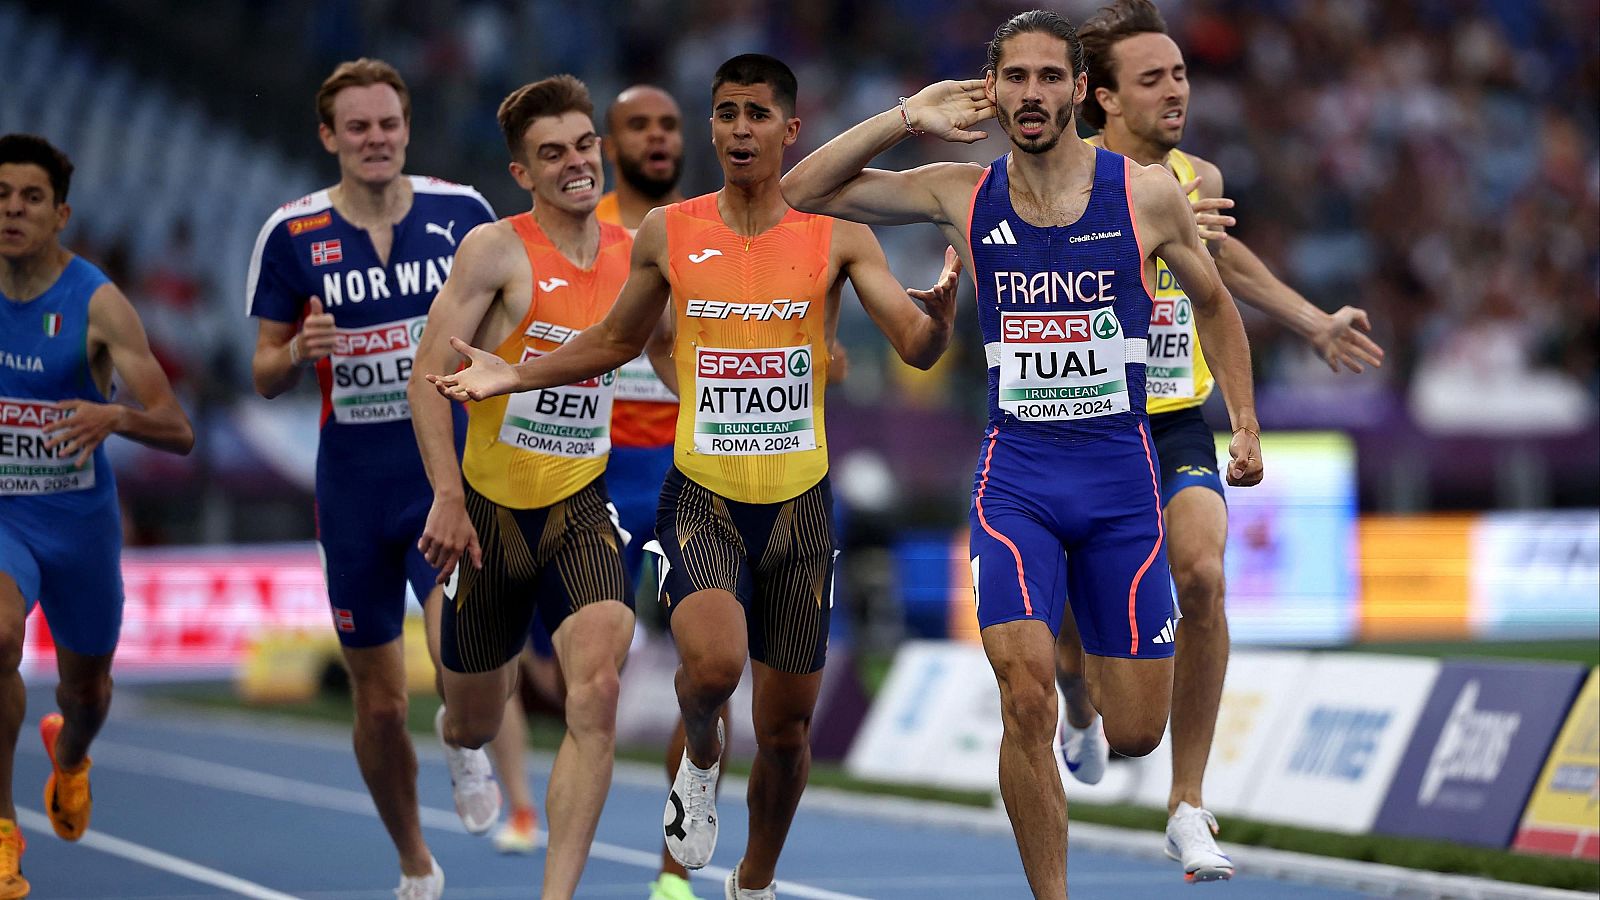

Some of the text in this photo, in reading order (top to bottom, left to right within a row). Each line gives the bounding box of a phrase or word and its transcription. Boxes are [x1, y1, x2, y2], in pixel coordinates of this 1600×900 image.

[1069, 229, 1122, 244] Crédit Mutuel
[994, 270, 1116, 304] FRANCE
[686, 298, 811, 321] ESPAÑA
[1005, 318, 1089, 340] SPAR
[335, 327, 408, 355] SPAR
[1147, 332, 1189, 359] MER
[335, 357, 413, 388] SOLB
[700, 354, 784, 376] SPAR
[1014, 349, 1108, 380] TUAL
[699, 382, 809, 414] ATTAOUI
[1025, 390, 1030, 399] I
[1031, 389, 1057, 399] RUN
[1146, 380, 1178, 394] 2024
[0, 404, 60, 425] PAR
[350, 404, 398, 419] ROMA
[535, 389, 600, 420] BEN
[1017, 399, 1113, 418] ROMA 2024
[534, 423, 559, 435] RUN
[559, 426, 593, 438] CLEAN
[724, 424, 750, 434] RUN
[516, 431, 596, 455] ROMA 2024
[712, 435, 800, 452] ROMA 2024
[43, 475, 79, 492] 2024
